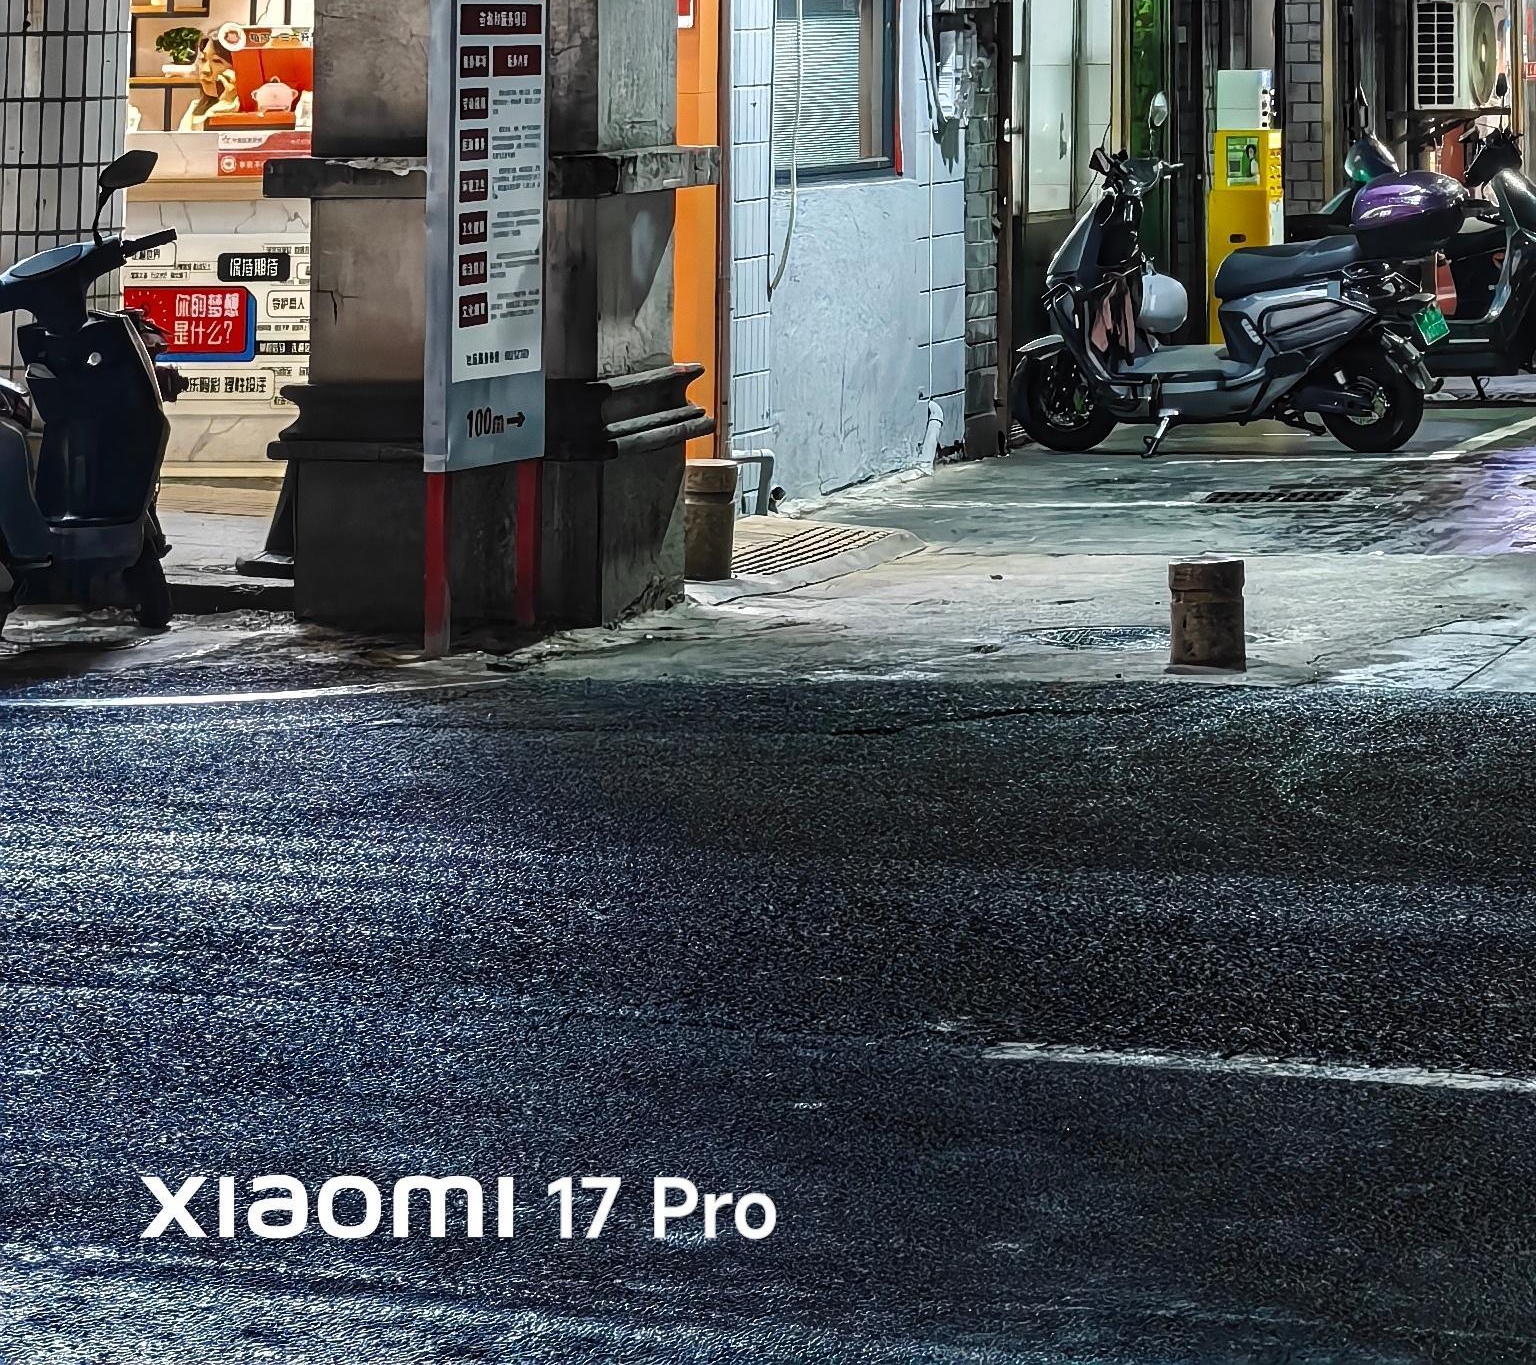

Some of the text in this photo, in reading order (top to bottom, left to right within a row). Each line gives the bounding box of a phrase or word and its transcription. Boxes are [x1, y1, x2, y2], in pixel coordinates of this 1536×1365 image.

[175, 293, 240, 317] 你的梦想
[185, 376, 221, 393] 乐购彩
[466, 407, 505, 438] 100m
